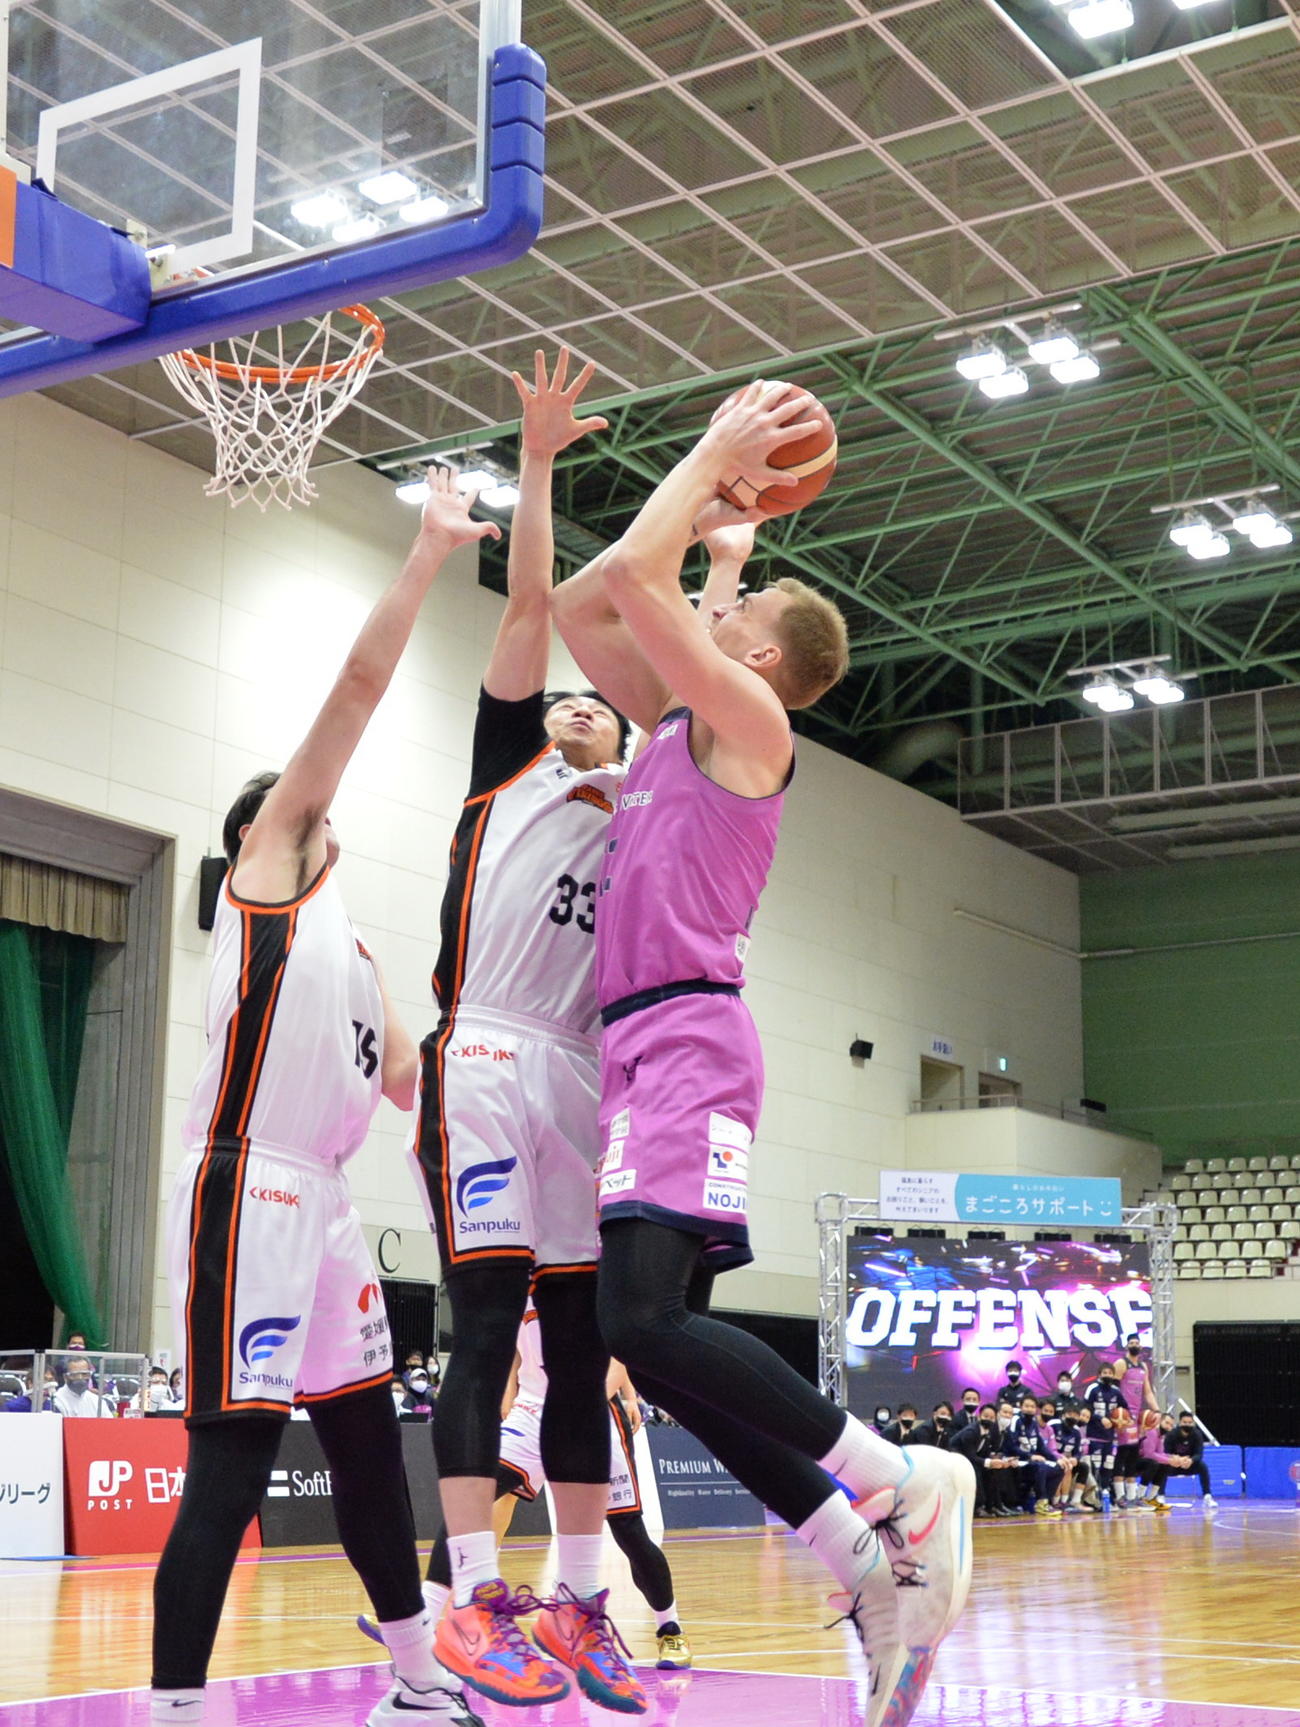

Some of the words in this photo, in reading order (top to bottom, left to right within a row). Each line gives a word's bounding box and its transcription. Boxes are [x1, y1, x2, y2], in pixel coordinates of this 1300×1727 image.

[549, 873, 596, 934] 33
[352, 1019, 379, 1080] 15
[965, 1194, 1094, 1217] まごころサポート
[459, 1218, 521, 1234] Sanpuku
[378, 1228, 401, 1273] C
[846, 1288, 1153, 1348] OFFENSE
[239, 1372, 293, 1387] Sanpuku
[87, 1499, 133, 1511] POST
